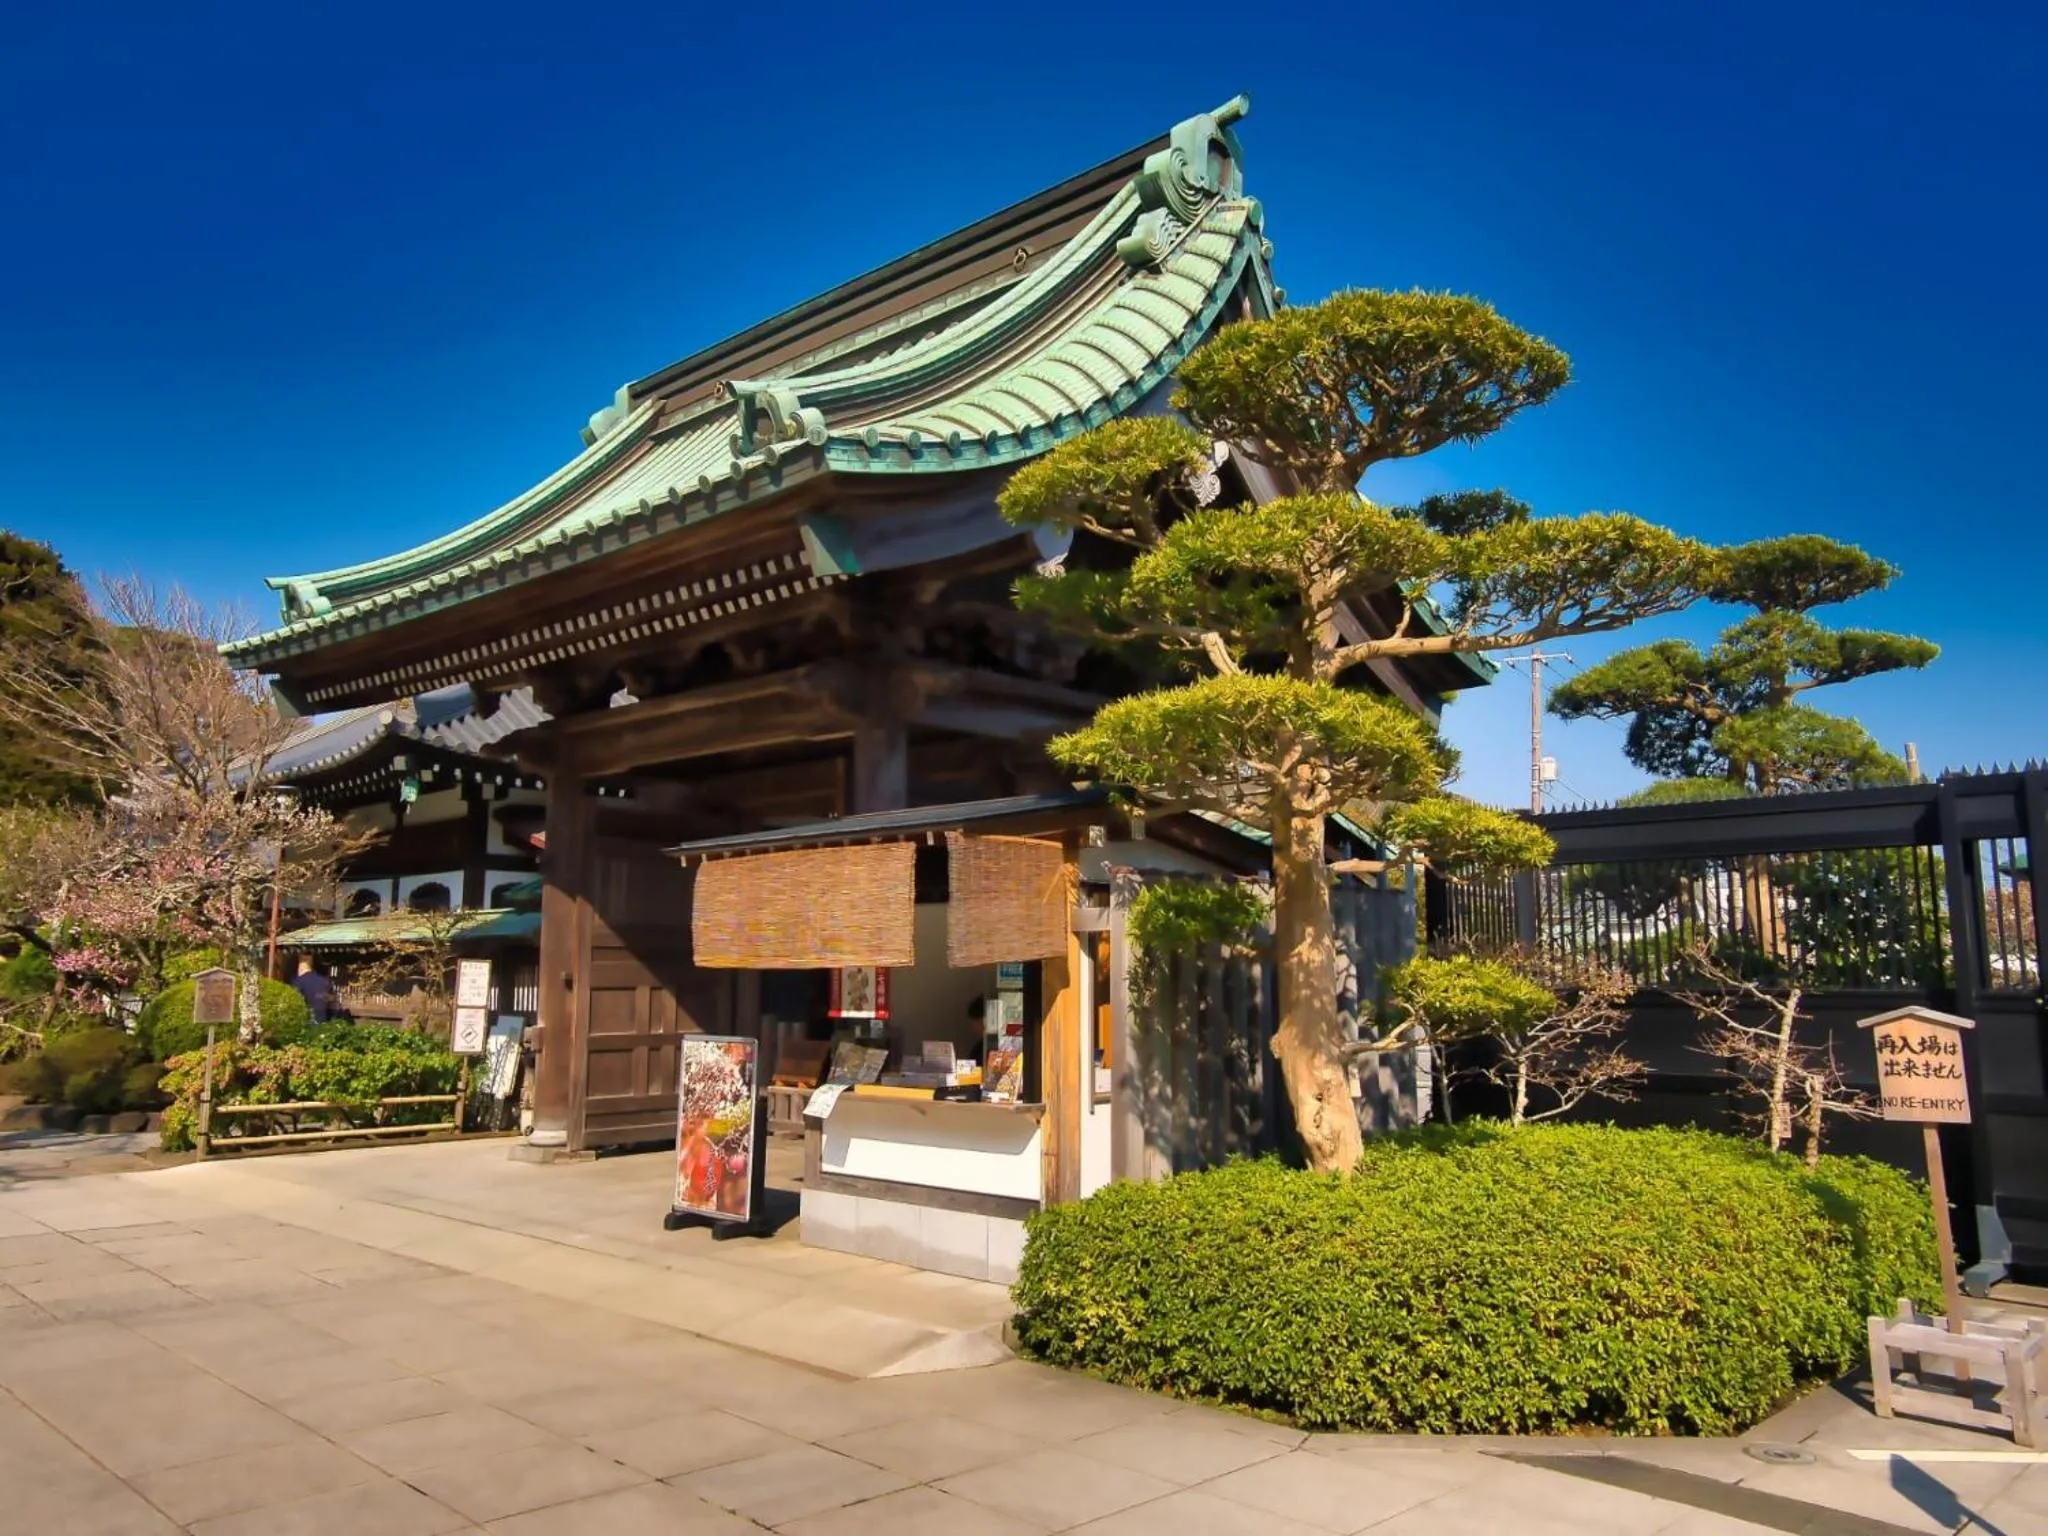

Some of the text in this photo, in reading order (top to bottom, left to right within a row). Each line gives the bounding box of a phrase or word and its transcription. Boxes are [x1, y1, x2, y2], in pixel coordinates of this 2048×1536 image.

[1877, 1034, 1958, 1056] 再入場は
[1884, 1058, 1962, 1079] 出来ません
[1883, 1096, 1965, 1111] NO RE-ENTRY
